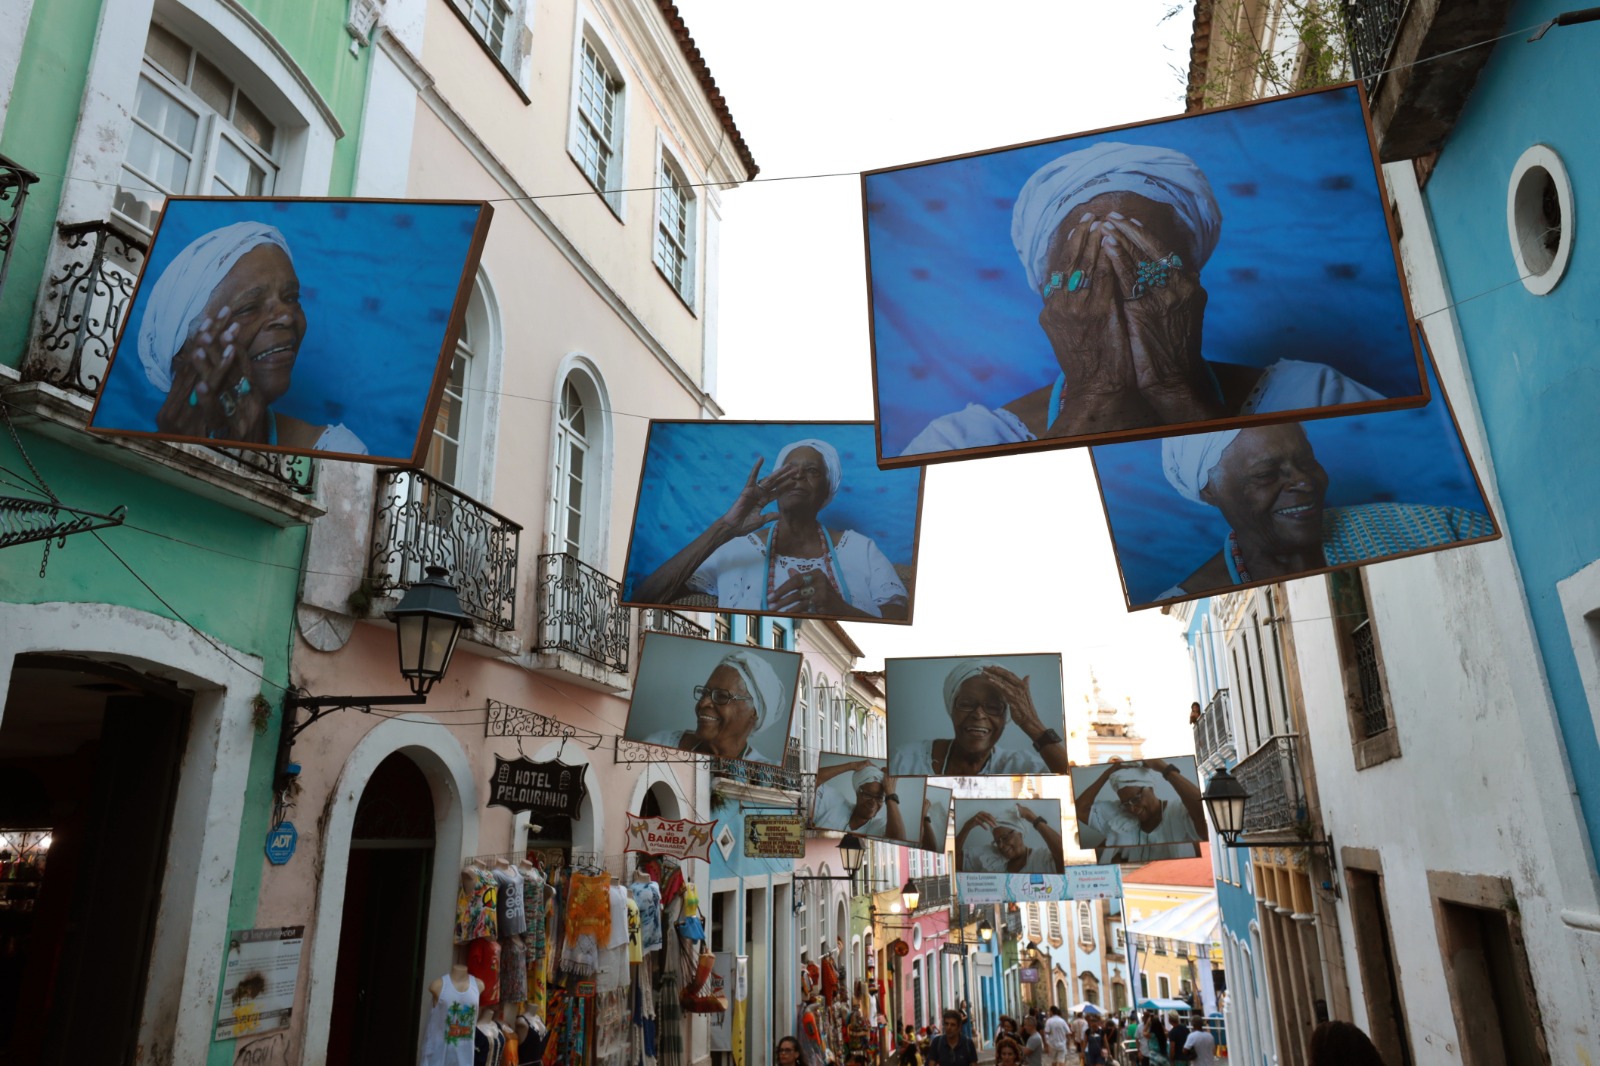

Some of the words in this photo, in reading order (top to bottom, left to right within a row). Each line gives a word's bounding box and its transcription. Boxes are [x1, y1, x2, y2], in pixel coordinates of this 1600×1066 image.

[515, 770, 551, 788] HOTEL
[496, 785, 567, 808] PELOURINHO
[657, 821, 684, 832] AXÉ
[272, 835, 293, 848] ADT
[648, 833, 687, 844] BAMBA
